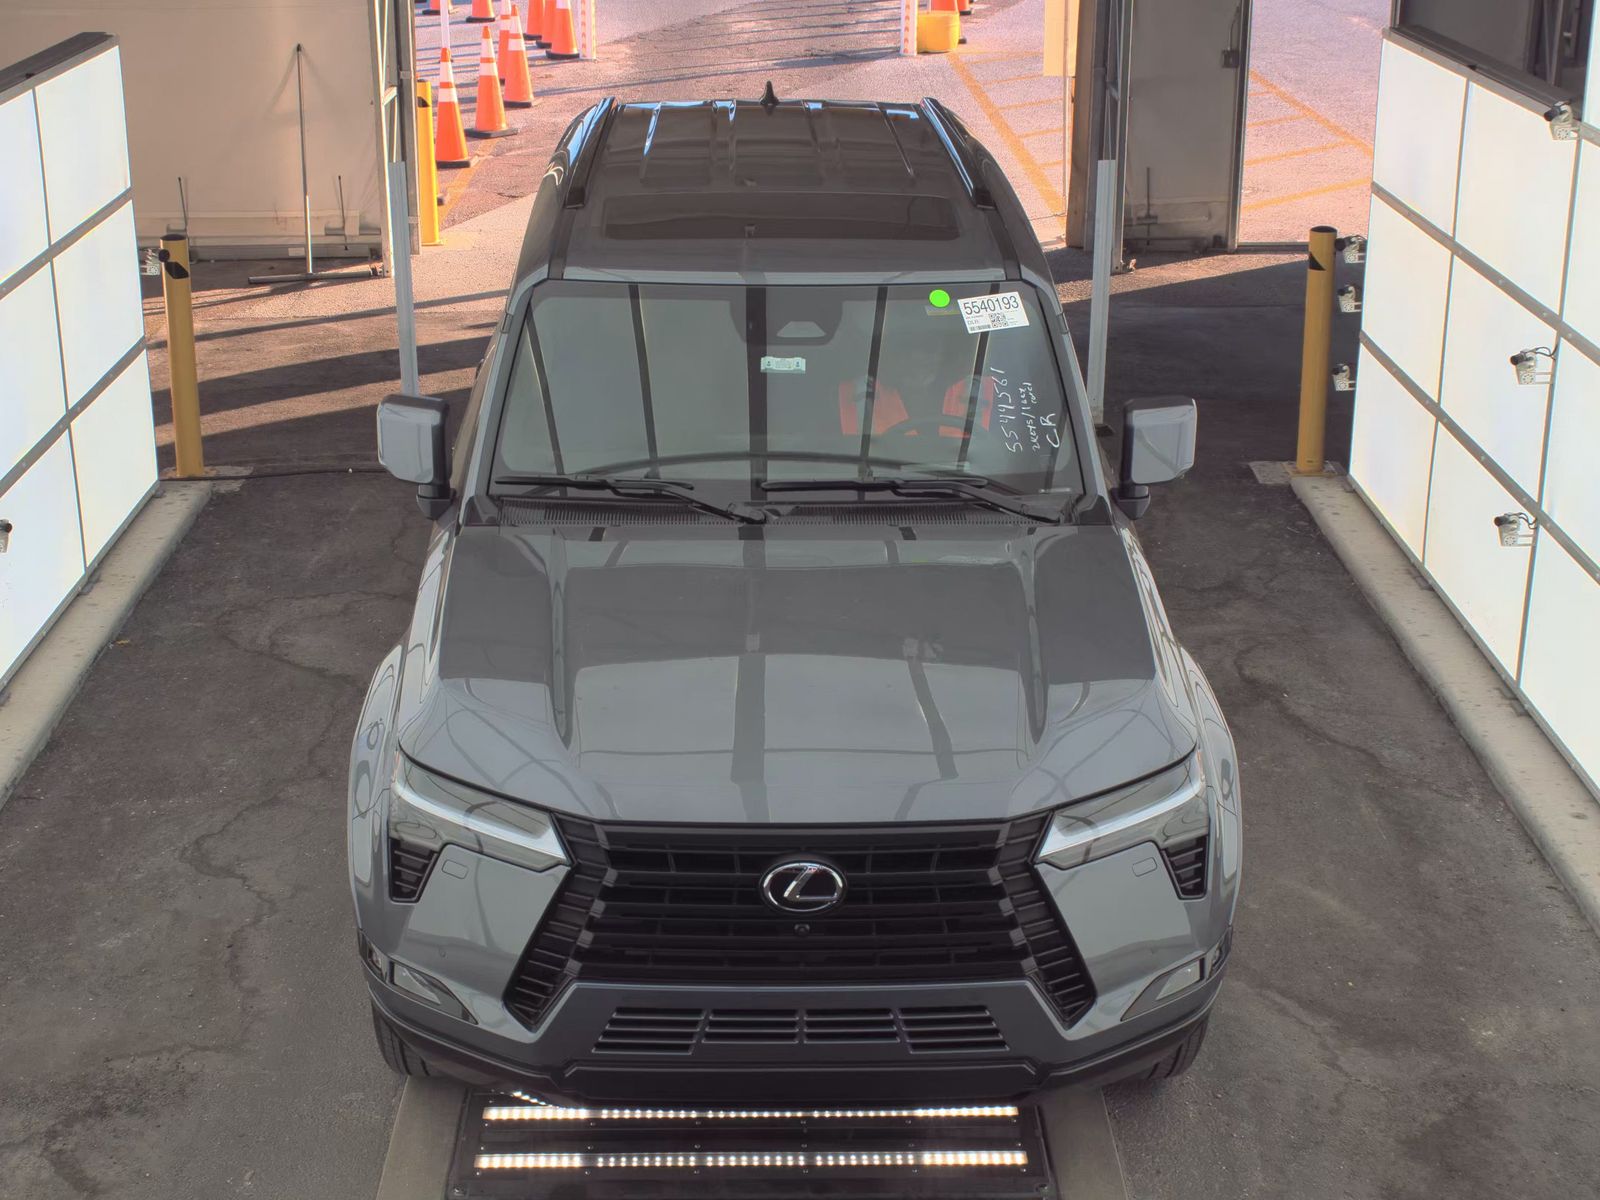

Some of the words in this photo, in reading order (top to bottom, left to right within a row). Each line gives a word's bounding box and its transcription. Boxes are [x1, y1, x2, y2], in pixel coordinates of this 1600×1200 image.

[963, 295, 1019, 315] 5540193
[990, 367, 1023, 453] 5544561
[1039, 413, 1060, 448] CR
